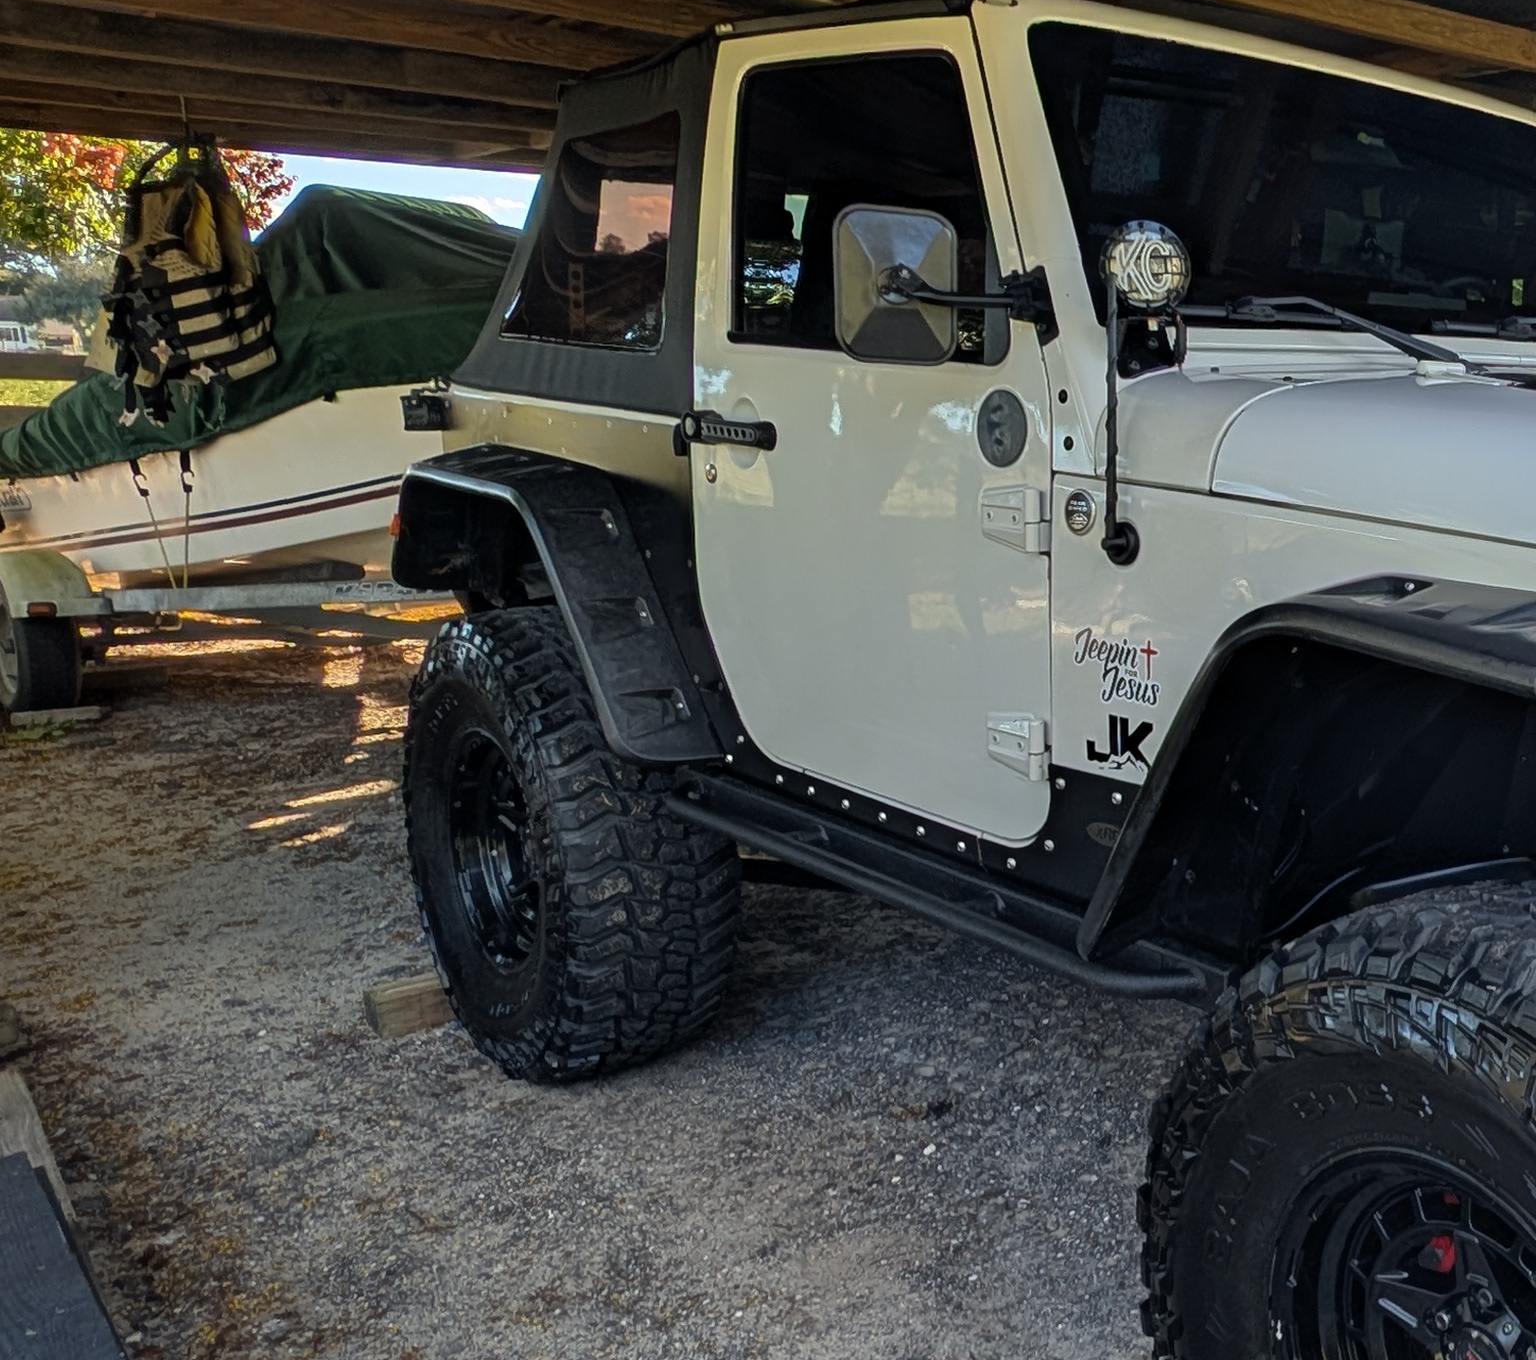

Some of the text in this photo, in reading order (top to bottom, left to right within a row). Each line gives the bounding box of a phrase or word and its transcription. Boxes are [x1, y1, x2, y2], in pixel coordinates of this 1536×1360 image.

[1115, 233, 1172, 301] KC
[1074, 627, 1138, 671] Jeepin
[1101, 665, 1160, 706] Jesus
[1124, 668, 1138, 678] FOR
[1086, 713, 1154, 768] JK
